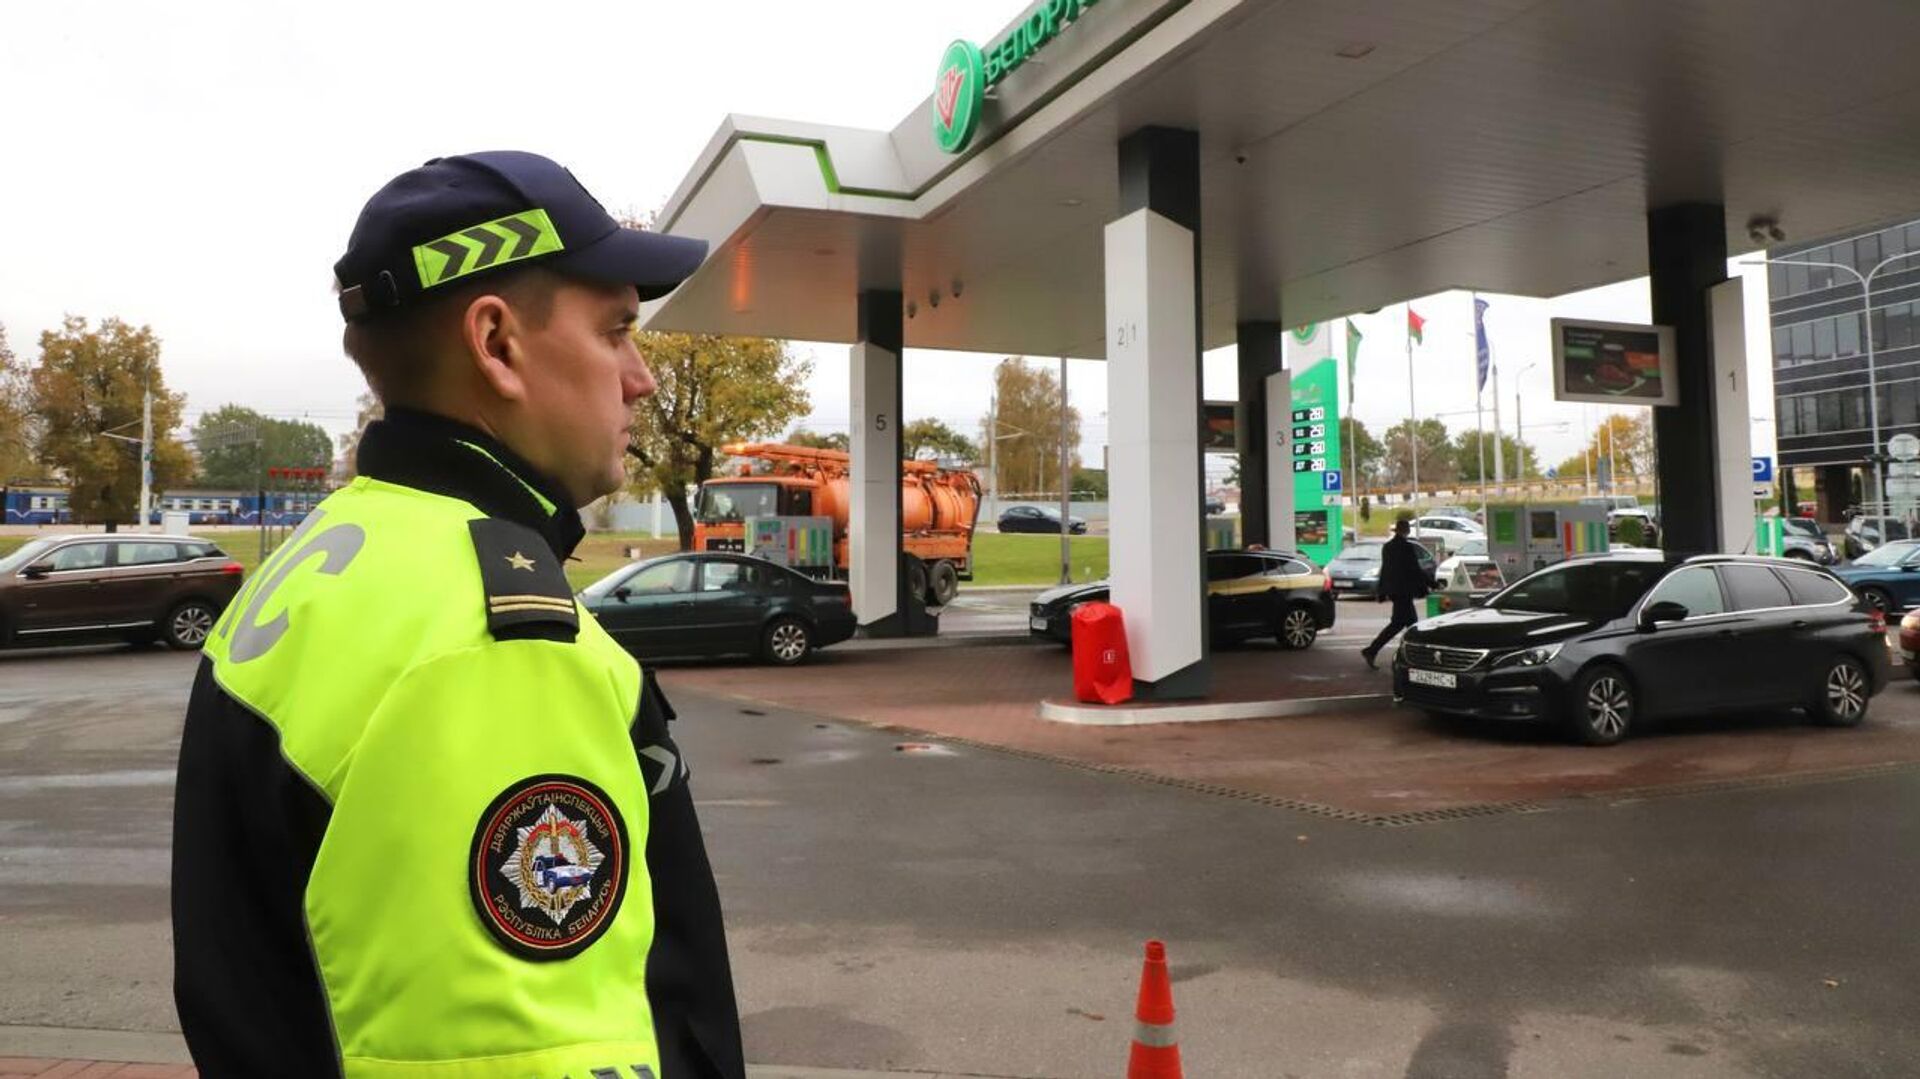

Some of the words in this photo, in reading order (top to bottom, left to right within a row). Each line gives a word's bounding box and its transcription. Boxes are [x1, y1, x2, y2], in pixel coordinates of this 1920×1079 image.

[1728, 370, 1737, 392] 1
[875, 414, 887, 431] 5
[1276, 430, 1285, 446] 3
[1325, 472, 1338, 490] P
[495, 894, 562, 939] РЭСПУБЛІКА
[568, 879, 611, 934] БЕЛАРУСЬ
